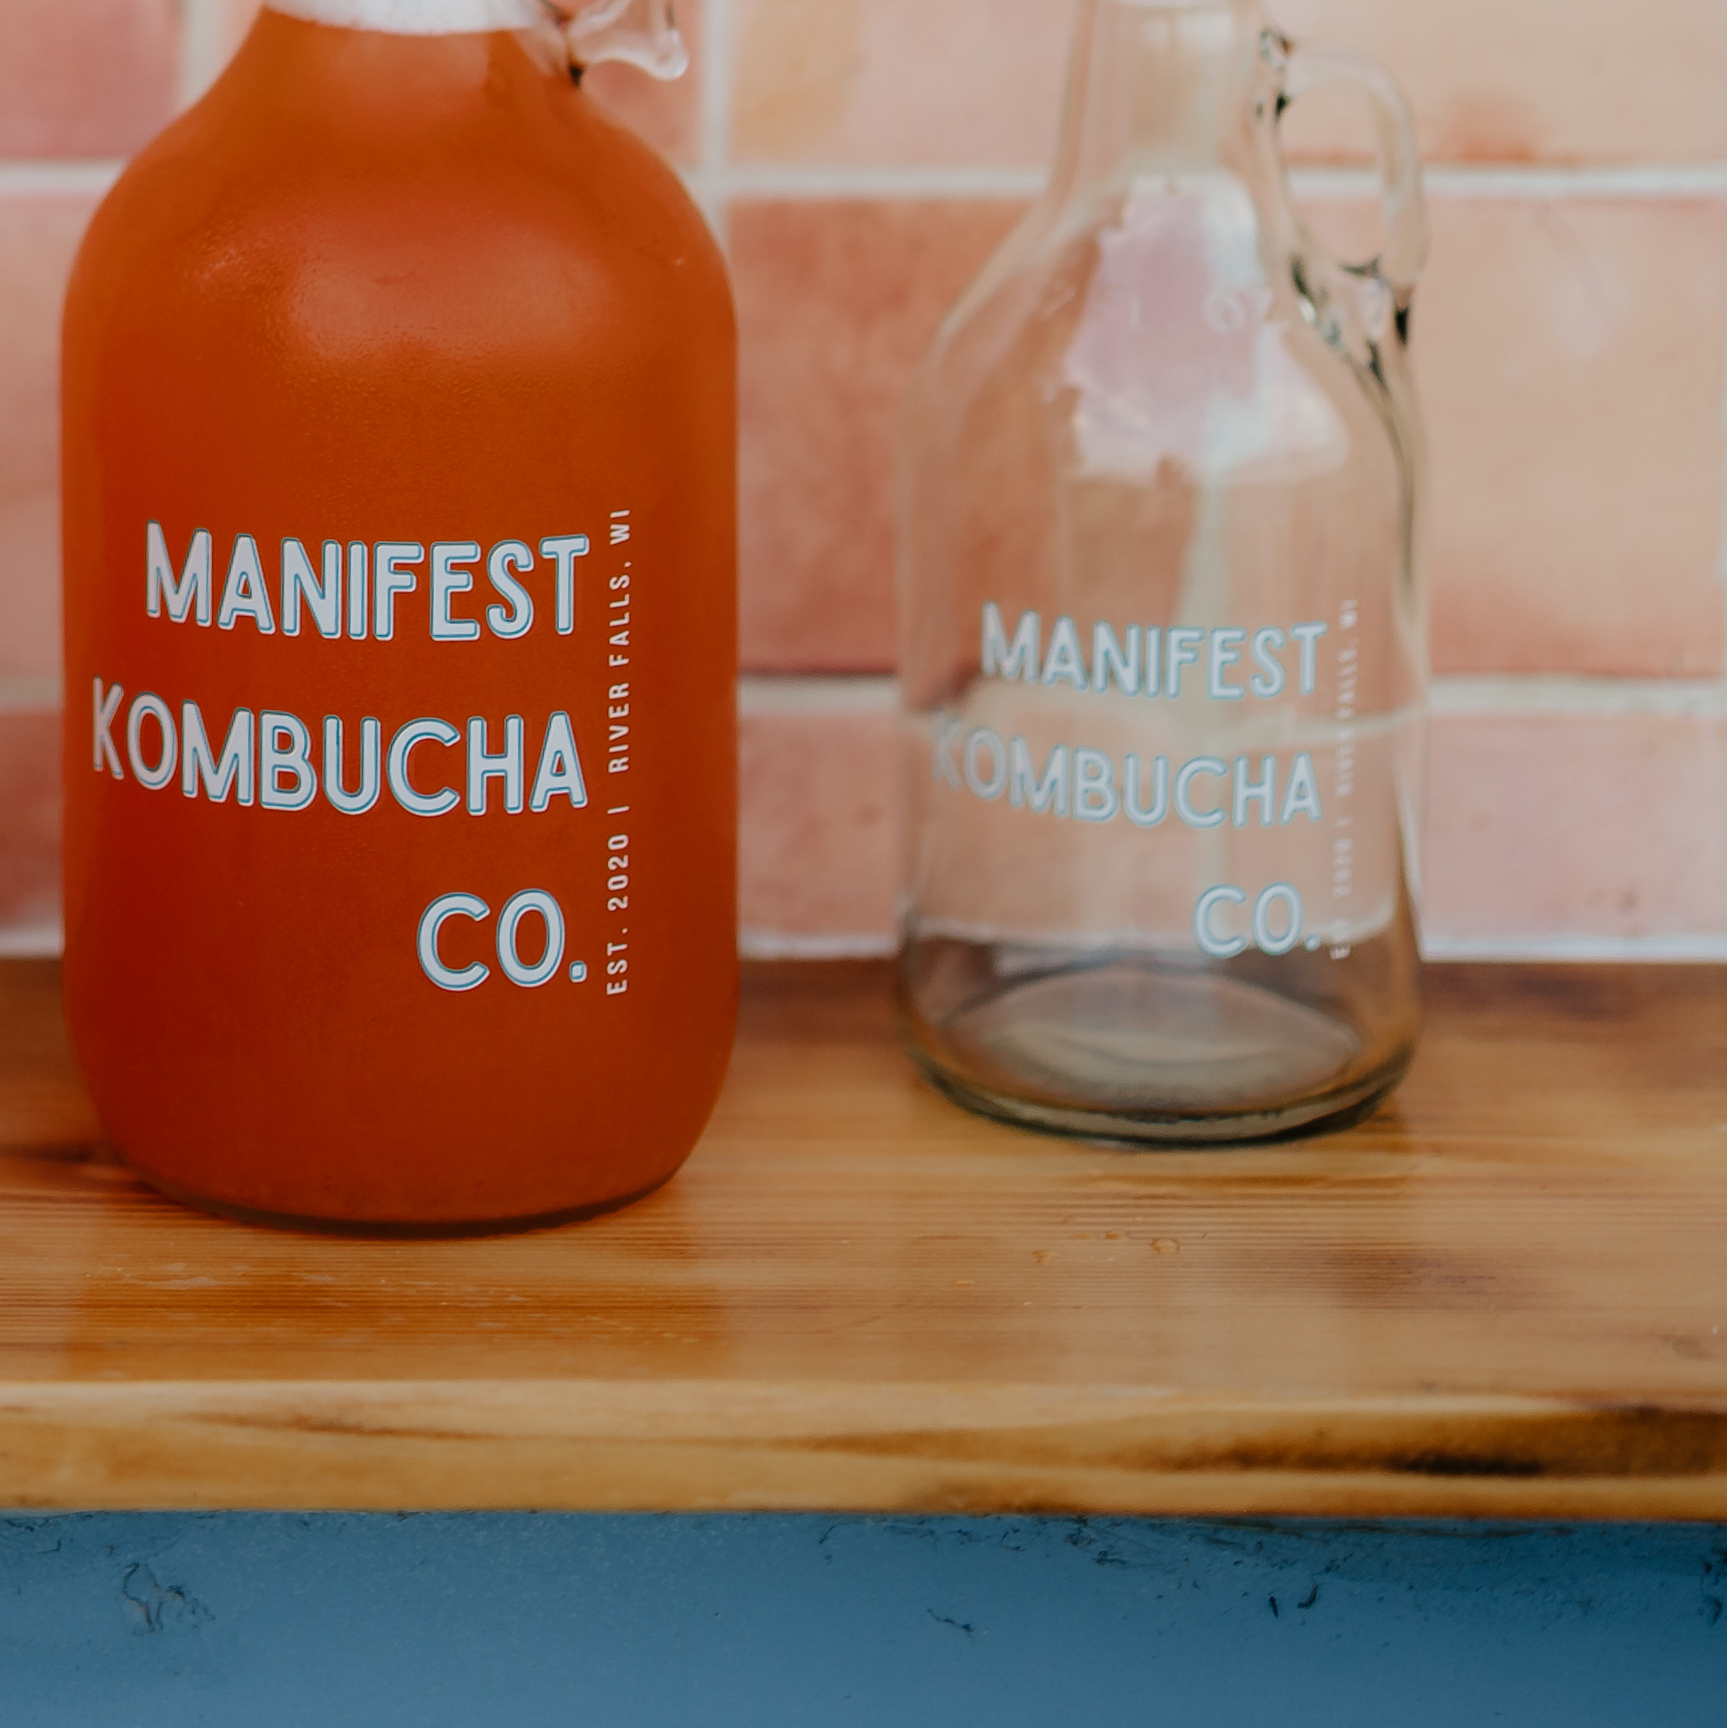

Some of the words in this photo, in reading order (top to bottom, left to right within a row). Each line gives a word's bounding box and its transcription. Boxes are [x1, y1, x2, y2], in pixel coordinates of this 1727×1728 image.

[609, 509, 631, 546] WI
[146, 519, 590, 641] MANIFEST
[981, 600, 1328, 698] MANIFEST
[92, 675, 589, 816] KOMBUCHA
[608, 682, 630, 774] RIVER
[932, 709, 1322, 829] KOMBUCHA
[607, 834, 629, 911] 2020
[1193, 882, 1322, 958] CO.
[416, 889, 588, 992] CO.
[606, 928, 628, 996] EST.
